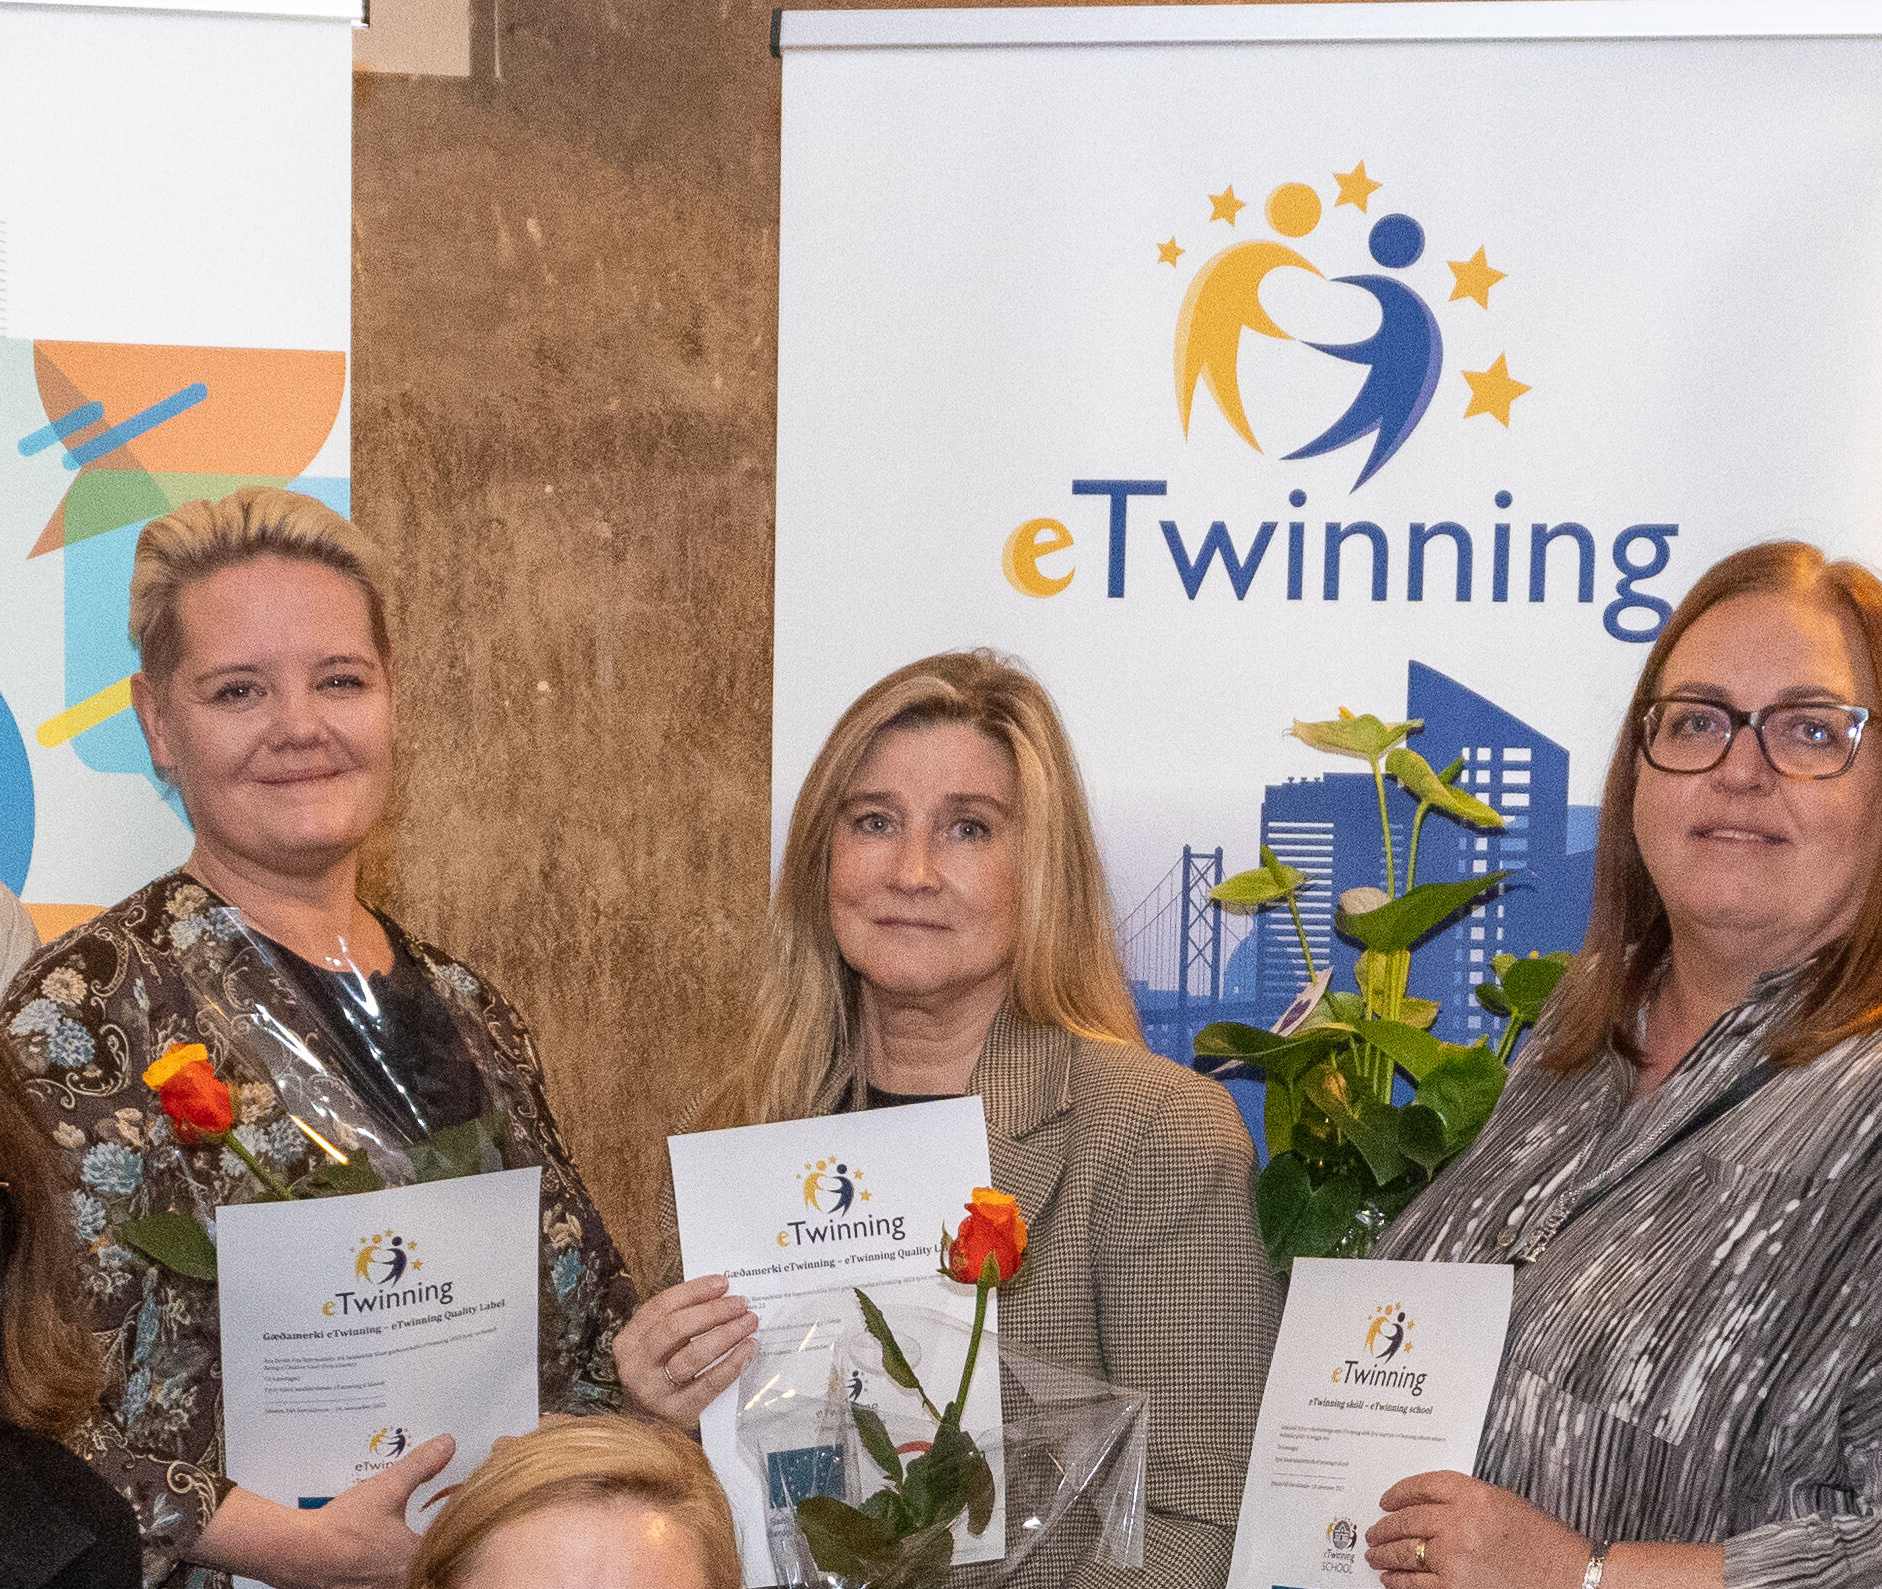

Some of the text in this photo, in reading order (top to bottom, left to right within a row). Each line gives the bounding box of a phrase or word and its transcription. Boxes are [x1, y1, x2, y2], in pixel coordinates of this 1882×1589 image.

[1002, 478, 1679, 643] eTwinning
[776, 1214, 906, 1247] eTwinning
[723, 1264, 782, 1279] Gæðamerki
[783, 1257, 836, 1273] eTwinning
[844, 1250, 897, 1266] eTwinning
[897, 1245, 933, 1260] Quality
[322, 1281, 454, 1316] eTwinning
[263, 1330, 324, 1342] Gæðamerki
[326, 1324, 382, 1339] eTwinning
[391, 1313, 443, 1330] eTwinning
[444, 1304, 478, 1322] Quality
[479, 1299, 506, 1312] Label
[1331, 1360, 1428, 1397] eTwinning
[1308, 1397, 1346, 1410] eTwinning
[1369, 1402, 1408, 1415] eTwinning
[1409, 1404, 1434, 1416] school
[1321, 1561, 1353, 1574] SCHOOL
